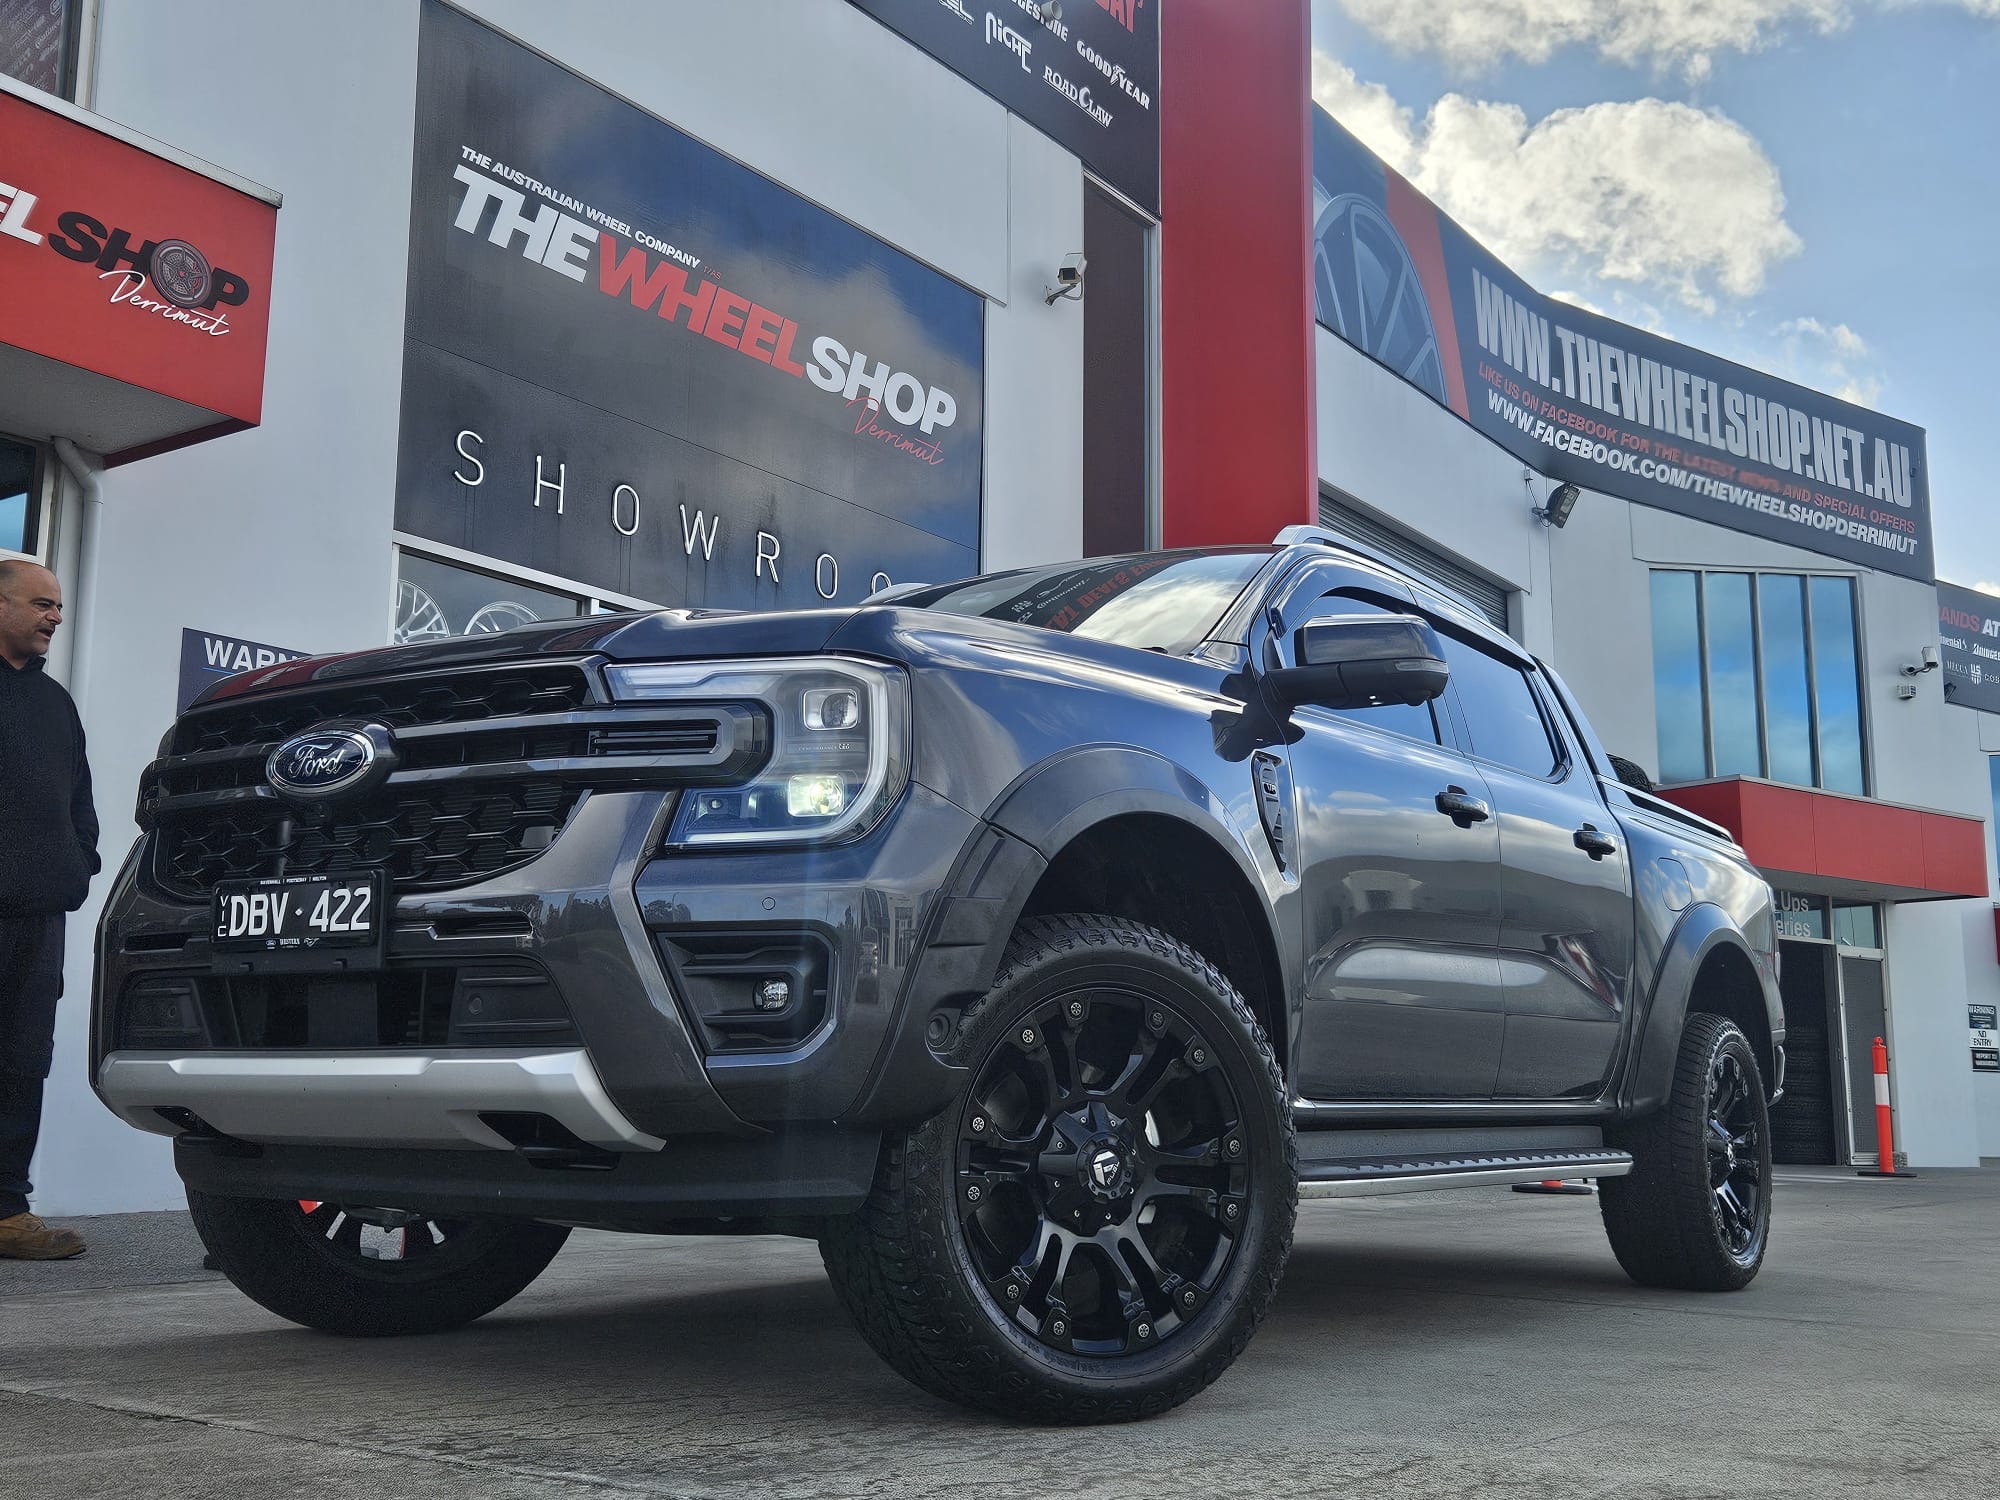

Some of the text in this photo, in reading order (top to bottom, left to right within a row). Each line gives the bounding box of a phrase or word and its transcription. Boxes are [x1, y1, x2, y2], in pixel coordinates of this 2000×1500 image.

[1077, 40, 1150, 110] GOODYEAR
[462, 145, 492, 169] THE
[493, 163, 584, 213] AUSTRALIAN
[586, 205, 632, 238] WHEEL
[634, 231, 700, 269] COMPANY
[99, 270, 229, 337] Derrimut
[453, 164, 956, 435] THE WHEEL SHOP
[1471, 267, 1912, 509] WWW.THEWHEELSHOP.NET.AU
[845, 397, 945, 466] Derrimut
[1479, 361, 1502, 389] LIKE
[1504, 377, 1520, 400] US
[1522, 390, 1539, 412] ON
[1540, 400, 1618, 444] FACEBOOK
[1621, 433, 1650, 454] FOR
[1654, 440, 1681, 463] THE
[1683, 452, 1737, 478] LATEST
[1782, 484, 1812, 503] AND
[1814, 492, 1867, 521] SPECIAL
[1870, 509, 1916, 534] OFFERS
[1488, 388, 1918, 556] WWW.FACEBOOK.COM/THEWHEELSHOPDERRIMUT
[1938, 607, 1980, 632] ANDS
[287, 743, 345, 778] Ford
[229, 887, 371, 937] DBV 422
[1781, 890, 1809, 917] Ups
[1973, 1038, 1992, 1047] ENTRY
